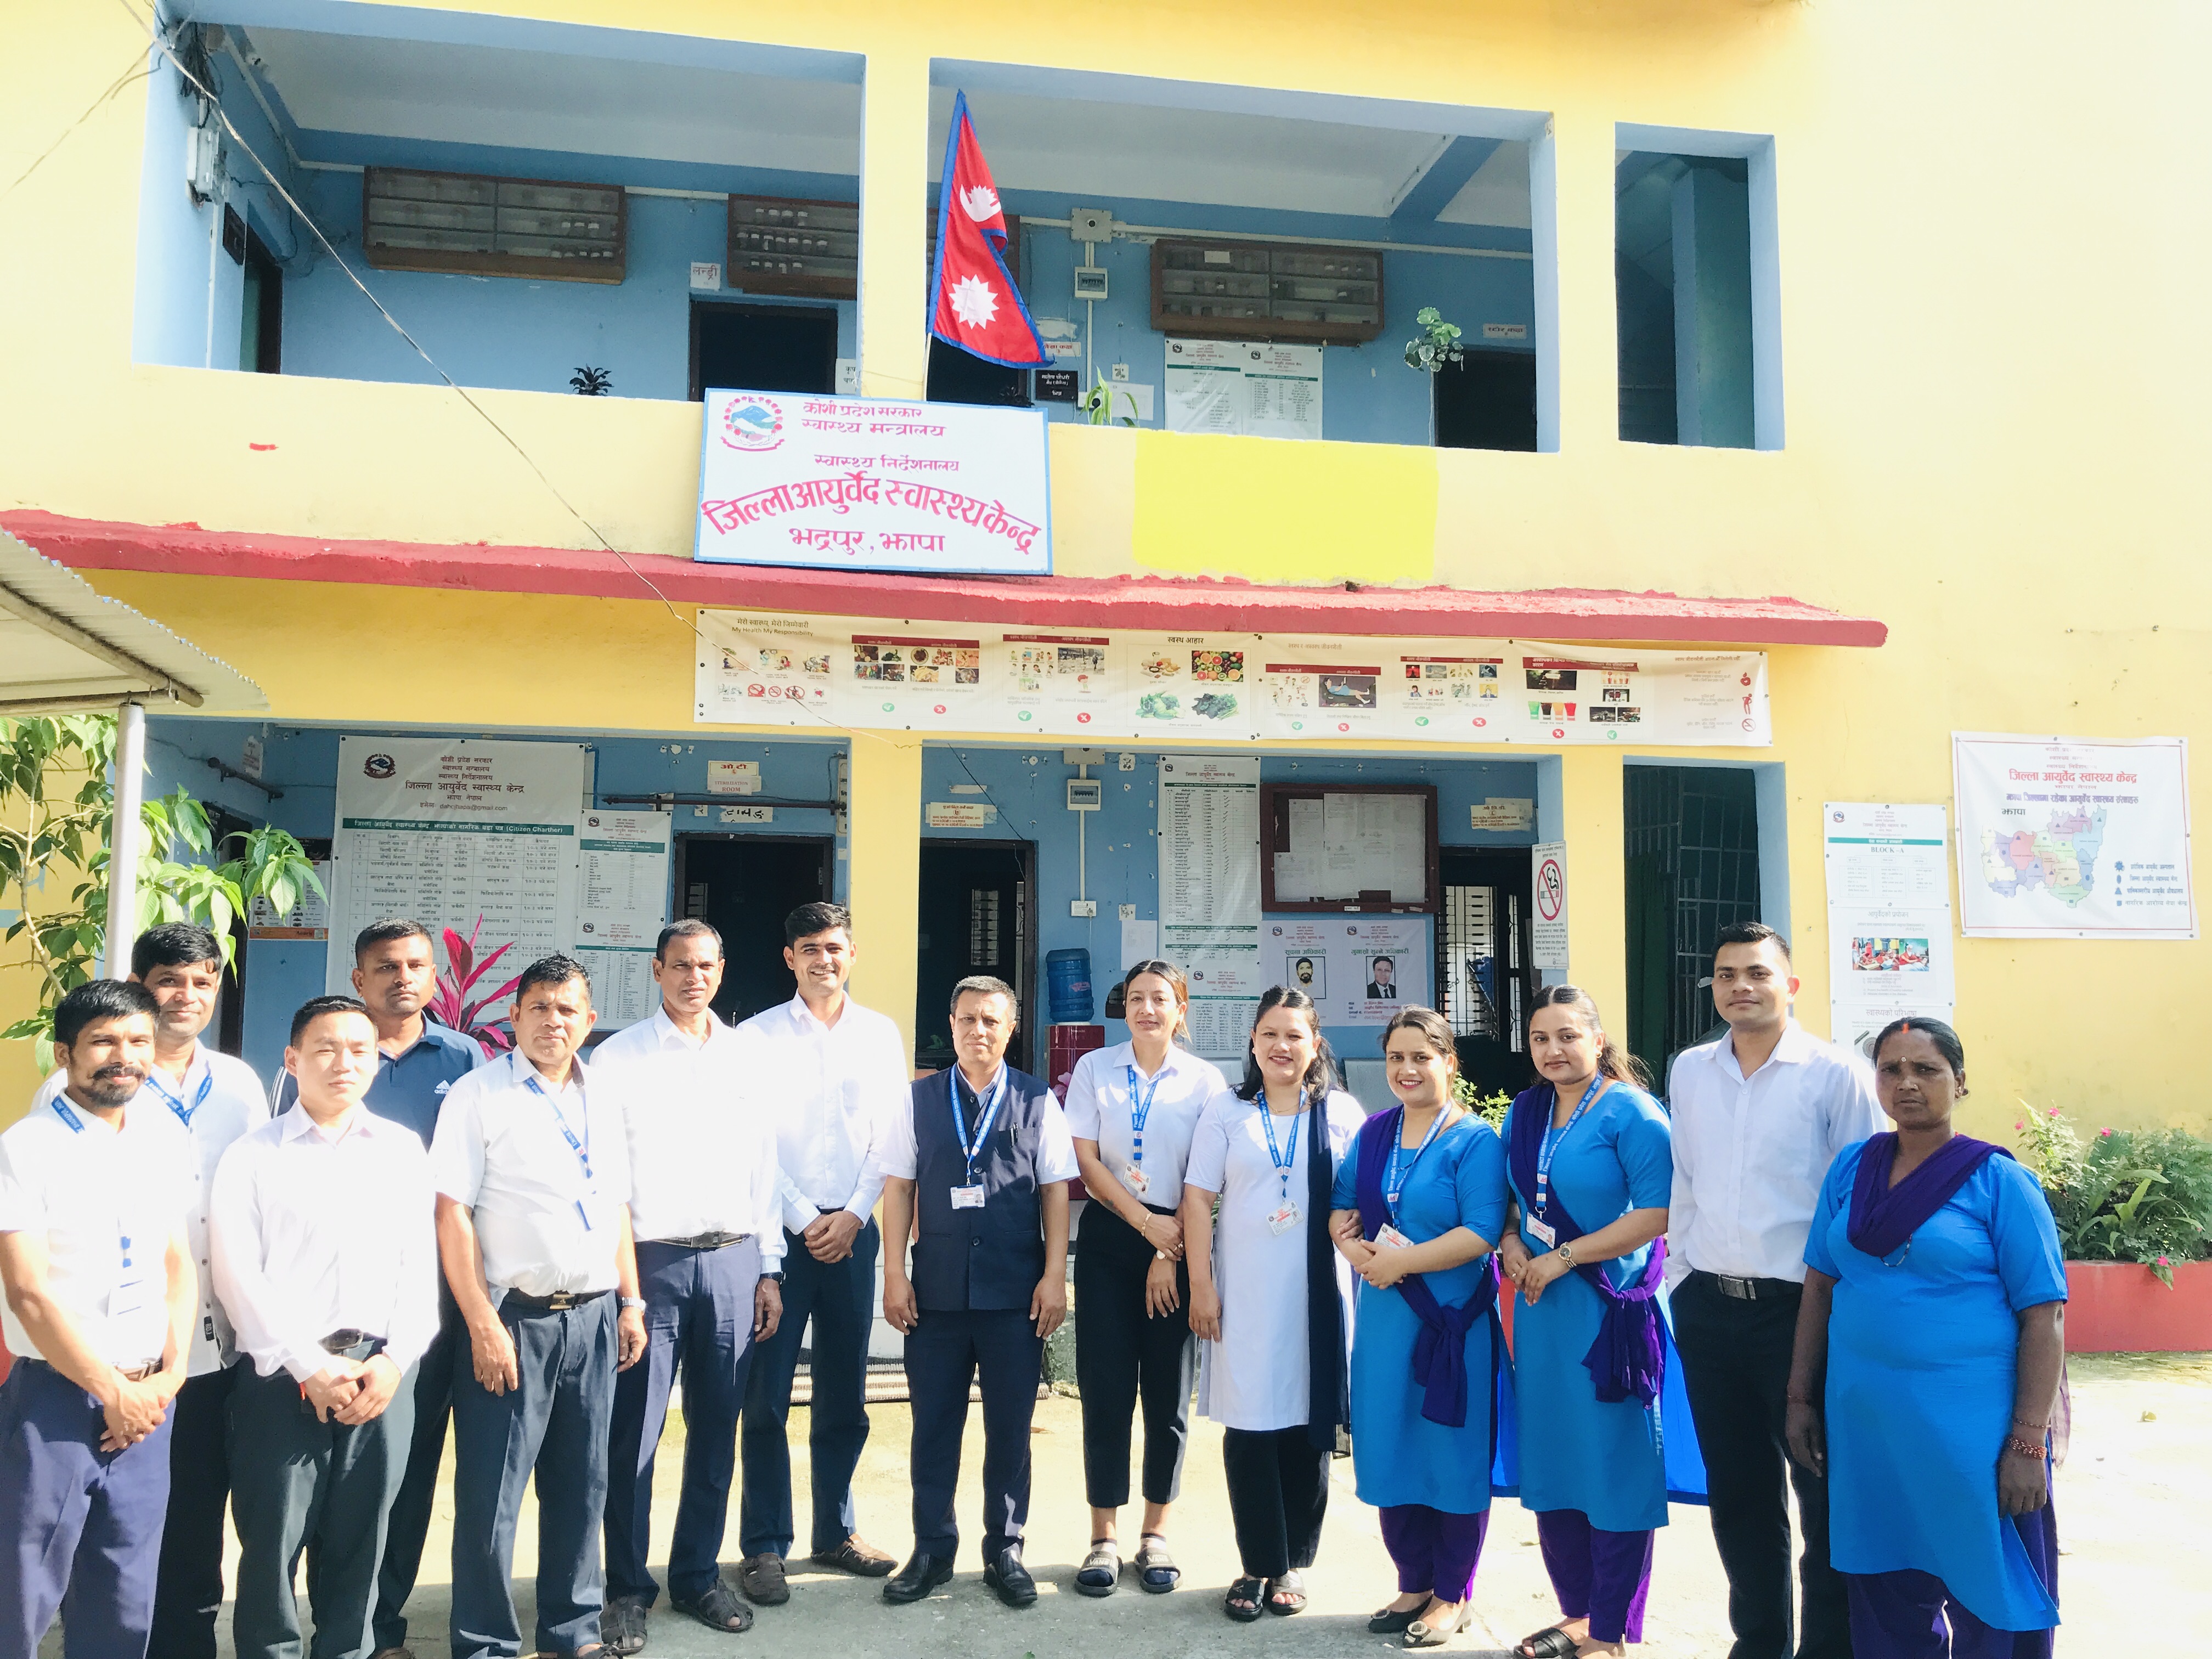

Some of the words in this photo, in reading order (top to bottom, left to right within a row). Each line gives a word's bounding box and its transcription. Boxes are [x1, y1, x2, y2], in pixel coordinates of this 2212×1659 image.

[804, 399, 837, 415] कोशी
[839, 401, 874, 417] प्रदेश
[878, 406, 922, 419] सरकार
[802, 419, 862, 434] स्वास्थ्य
[870, 423, 947, 437] मन्त्रालय
[814, 454, 876, 469] स्वास्थ्य
[881, 454, 959, 472] निर्देशनालय
[885, 479, 988, 527] स्वास्थ्य
[986, 499, 1041, 555] केन्द्र
[879, 532, 945, 552] झापा
[2009, 769, 2039, 781] जिल्ला
[2042, 770, 2075, 783] आयुर्वेद
[2079, 772, 2113, 783] स्वास्थ्य
[2116, 771, 2137, 784] केन्द्र
[405, 780, 432, 790] जिल्ला
[438, 781, 467, 793] आयुर्वेद
[472, 784, 501, 792] स्वास्थ्य
[506, 782, 524, 793] केन्द्र
[1867, 910, 1891, 918] आयुर्वेदको
[1866, 1008, 1892, 1016] स्वास्थ्यको
[1894, 1008, 1917, 1017] परिभाषा
